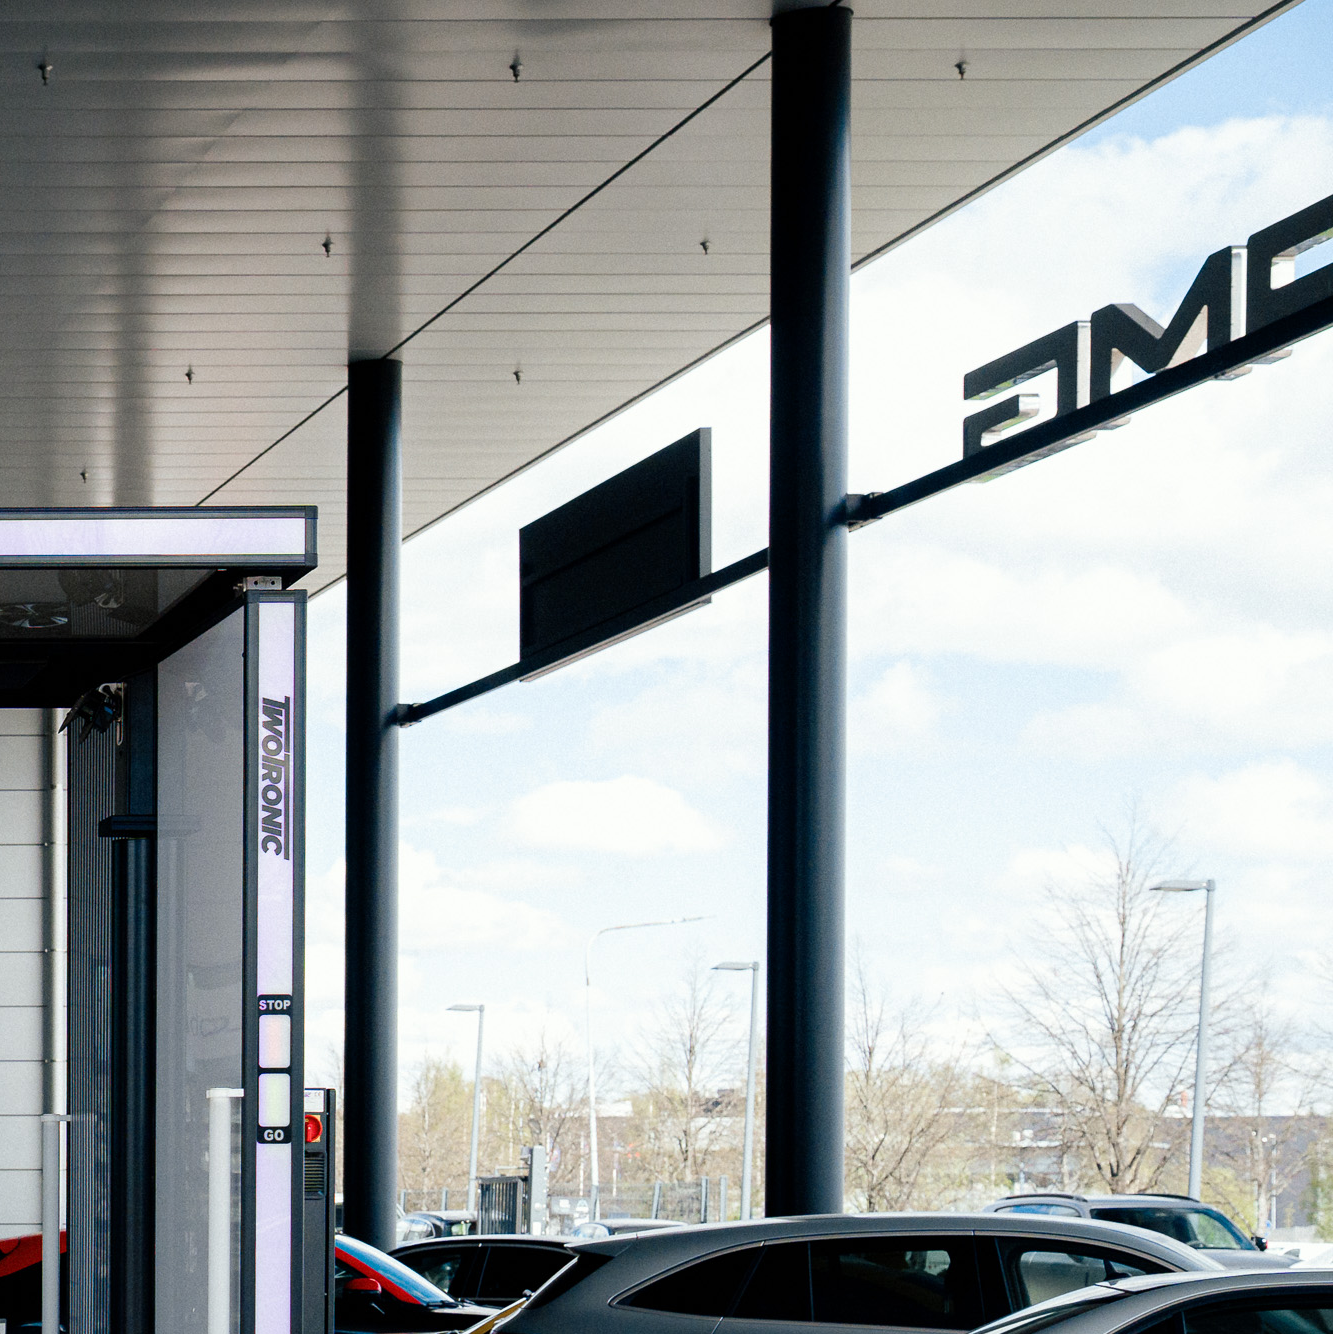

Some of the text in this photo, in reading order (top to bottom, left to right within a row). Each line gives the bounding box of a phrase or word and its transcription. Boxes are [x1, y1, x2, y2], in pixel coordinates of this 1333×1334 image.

[261, 695, 291, 861] TWOTRONIC
[259, 1000, 291, 1011] STOP
[263, 1129, 285, 1141] GO
